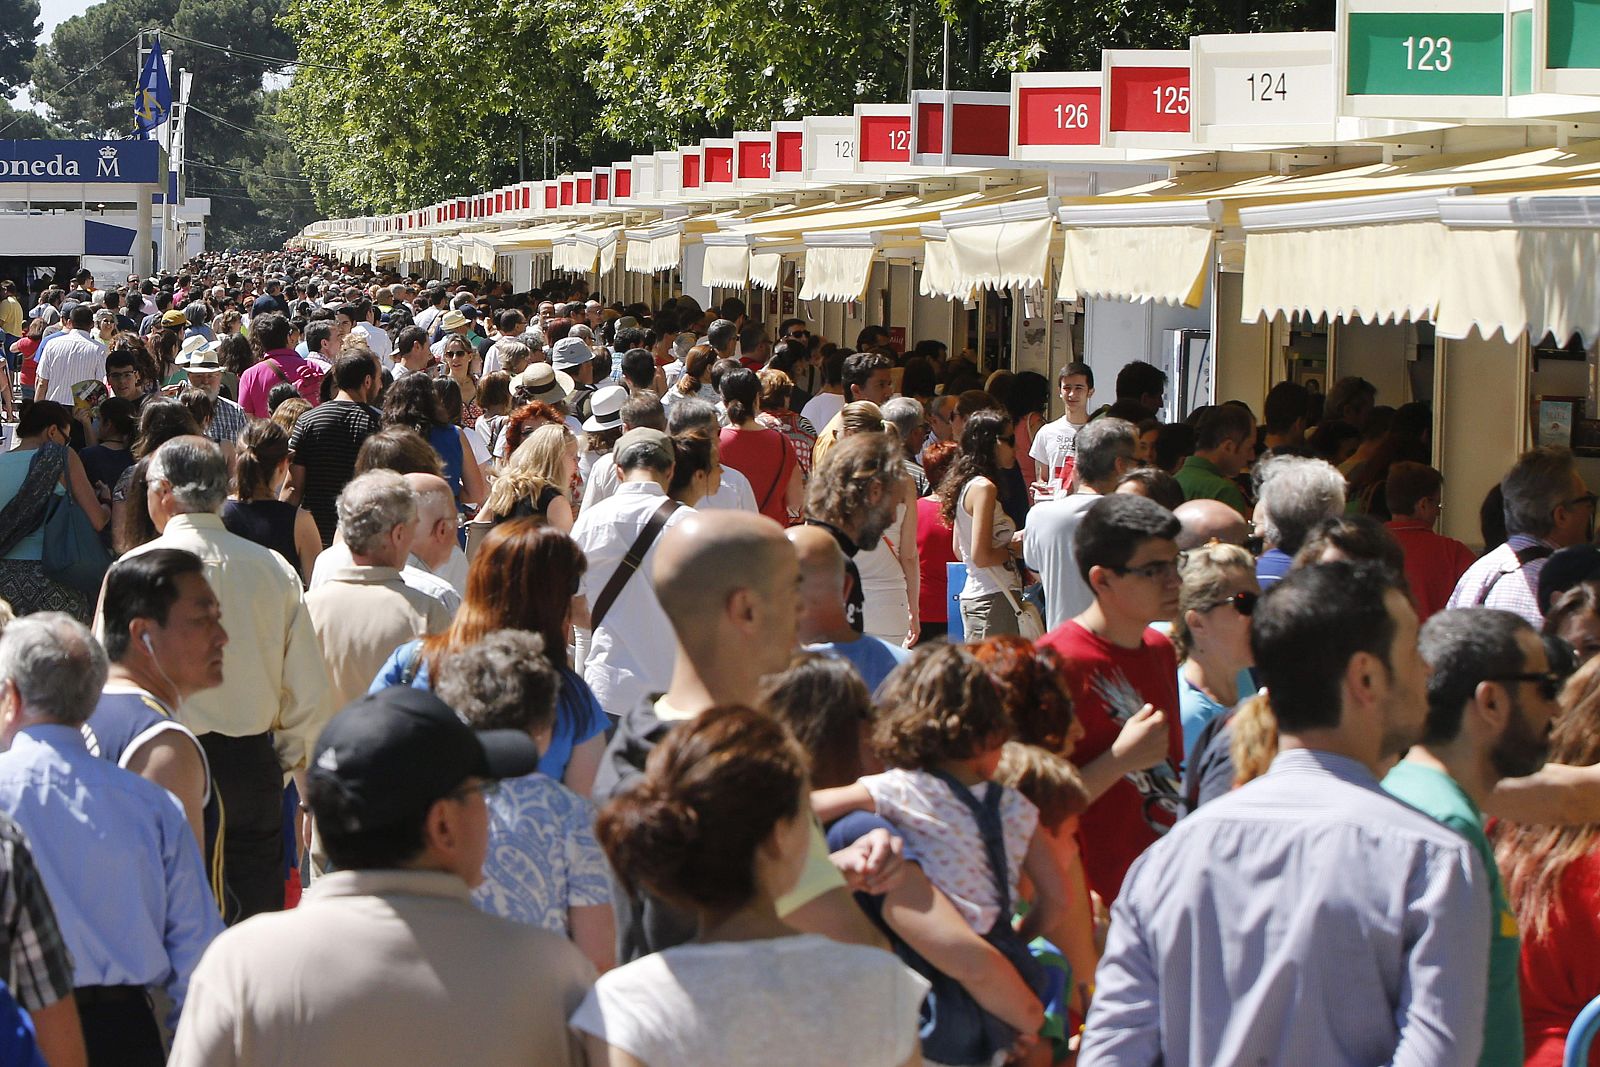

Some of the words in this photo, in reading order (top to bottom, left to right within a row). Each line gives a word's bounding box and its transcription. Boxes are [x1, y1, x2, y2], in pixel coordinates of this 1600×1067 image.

[1402, 36, 1452, 72] 123
[1152, 86, 1190, 114] 125
[1247, 73, 1287, 101] 124
[1053, 103, 1089, 129] 126
